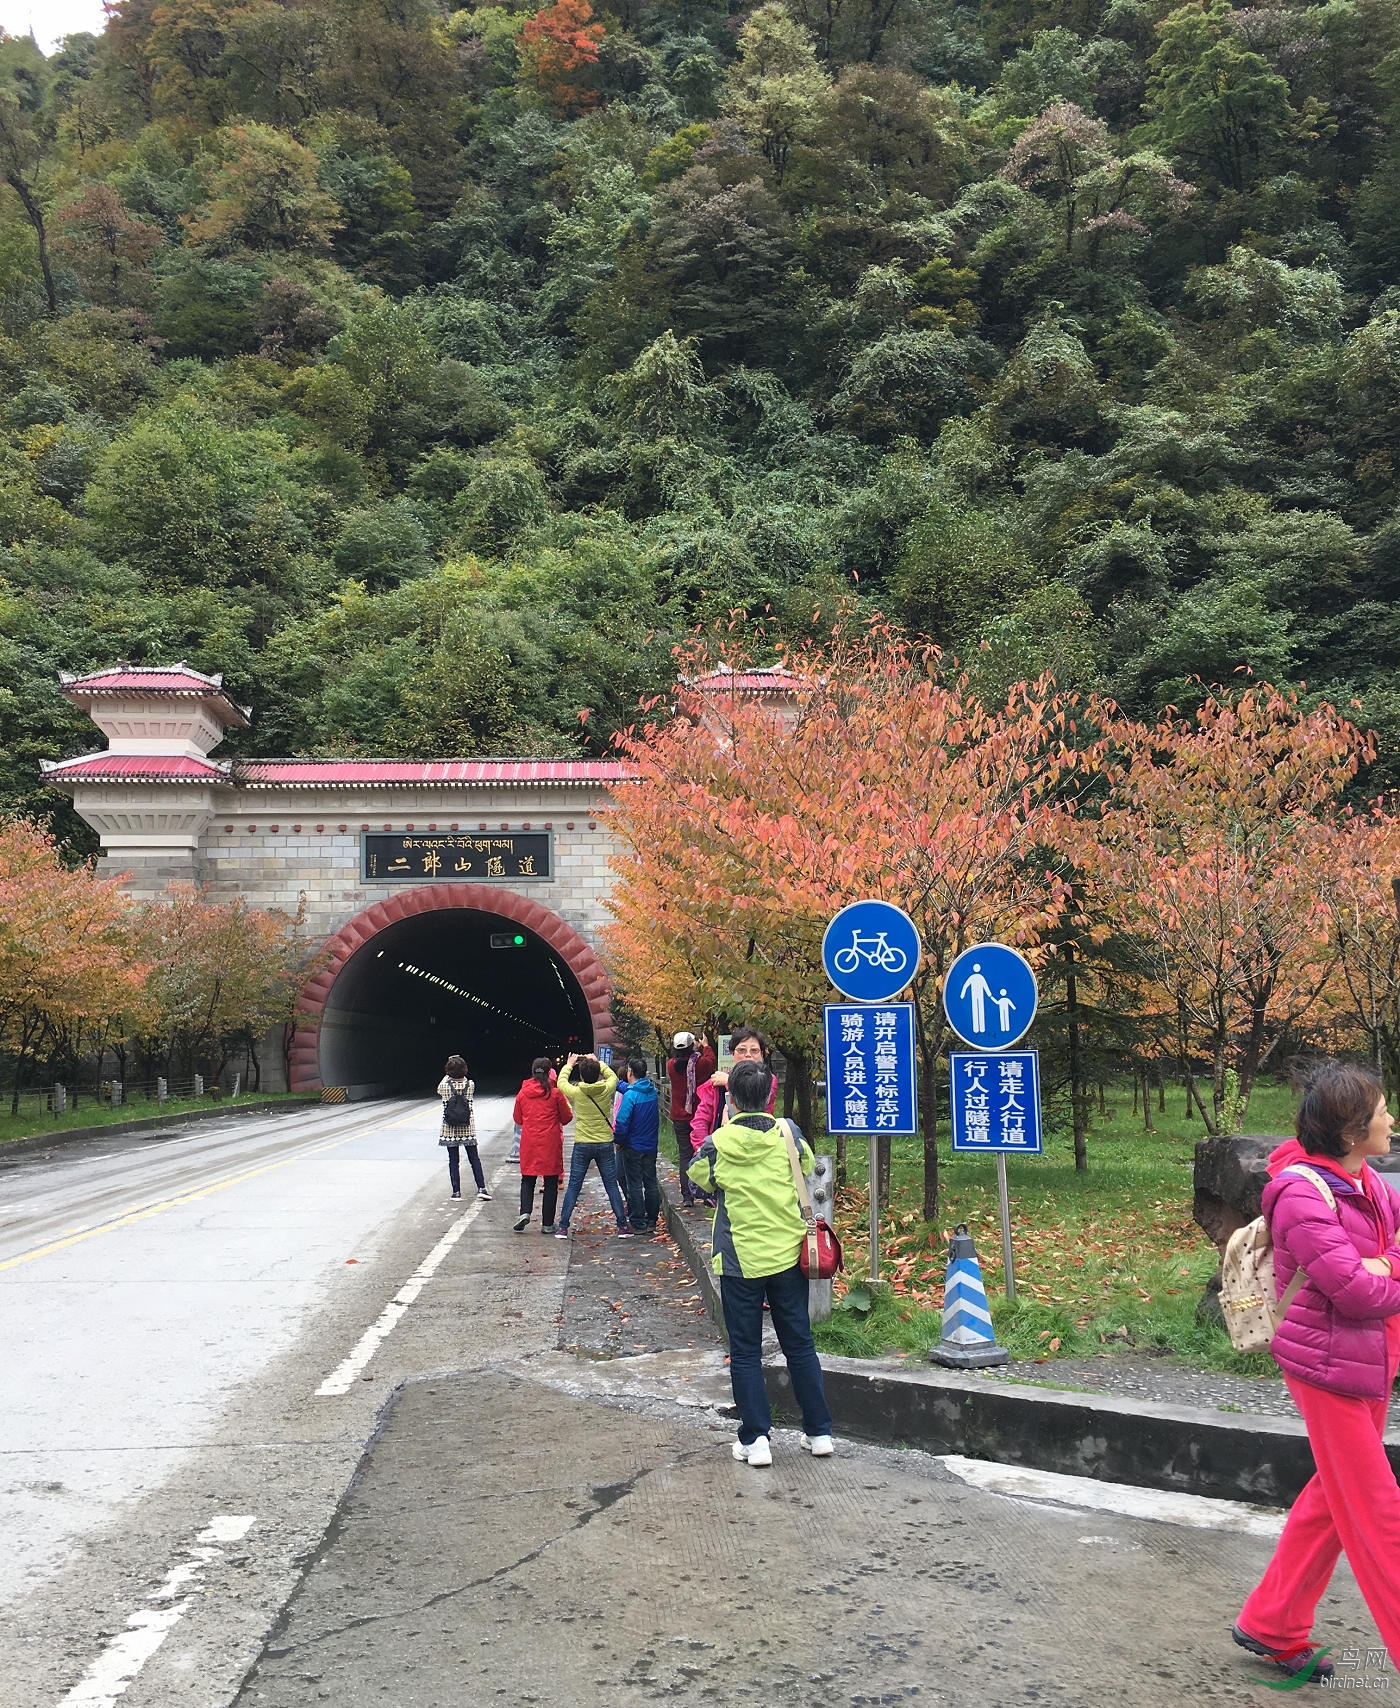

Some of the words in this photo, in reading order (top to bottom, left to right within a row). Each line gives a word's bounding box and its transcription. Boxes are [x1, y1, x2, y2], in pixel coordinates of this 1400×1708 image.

[387, 850, 538, 878] 二郎山隧道
[840, 1013, 869, 1128] 骑游人员进入隧道
[873, 1012, 900, 1128] 请开启警示标志灯
[963, 1061, 991, 1143] 行人过隧道
[997, 1061, 1028, 1145] 请走人行道
